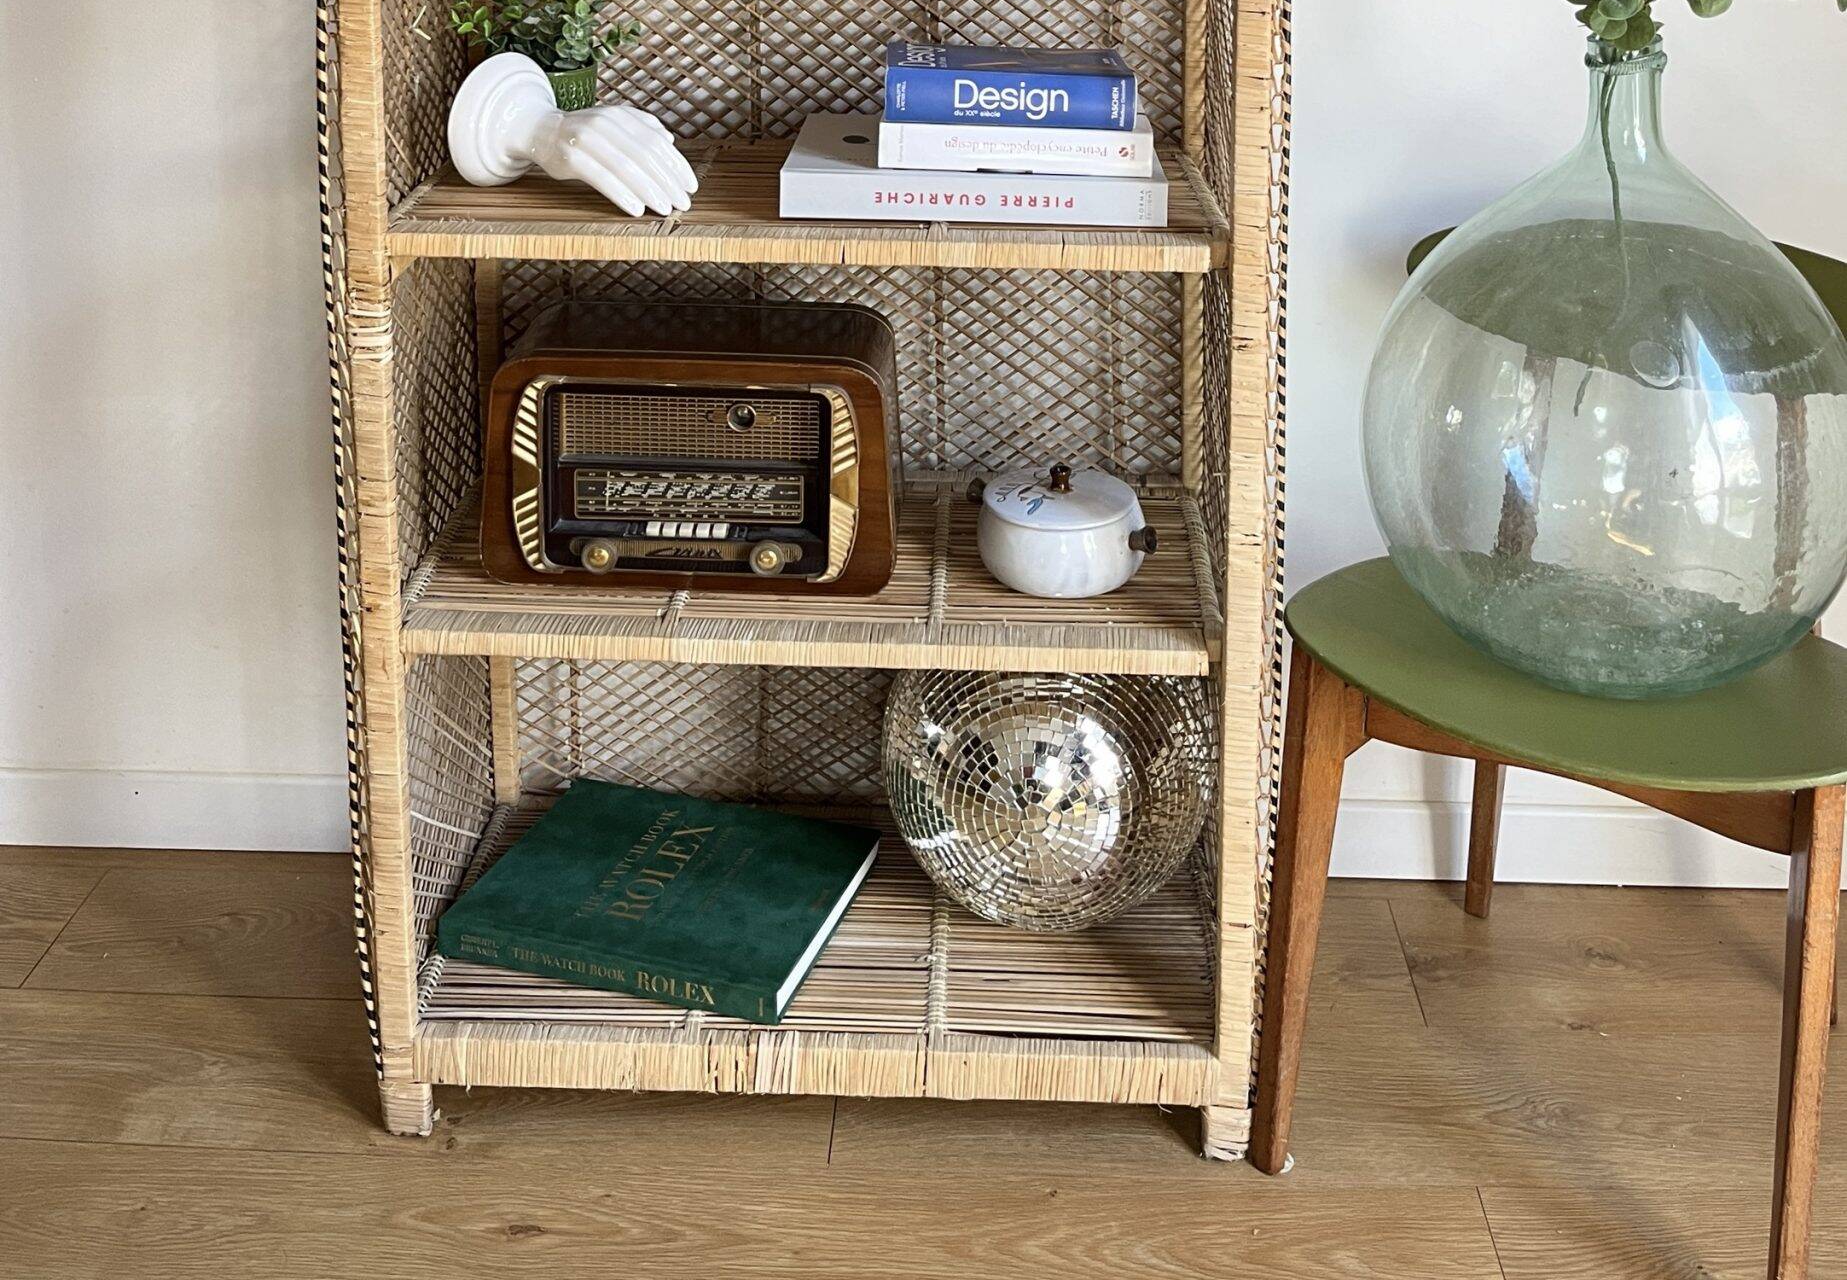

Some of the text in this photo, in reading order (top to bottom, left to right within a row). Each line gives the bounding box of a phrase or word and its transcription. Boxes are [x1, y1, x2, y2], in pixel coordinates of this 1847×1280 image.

[953, 109, 963, 117] du
[954, 79, 1069, 120] Design
[1111, 86, 1119, 120] TASCHEN
[944, 136, 979, 153] design
[984, 141, 997, 153] du
[1075, 145, 1108, 158] Petite
[874, 192, 1074, 209] PIERRE GUARICHE
[642, 808, 681, 843] BOOK
[606, 823, 715, 921] ROLEX
[512, 946, 626, 983] THE WATCH BOOK
[636, 970, 716, 1006] ROLEX
